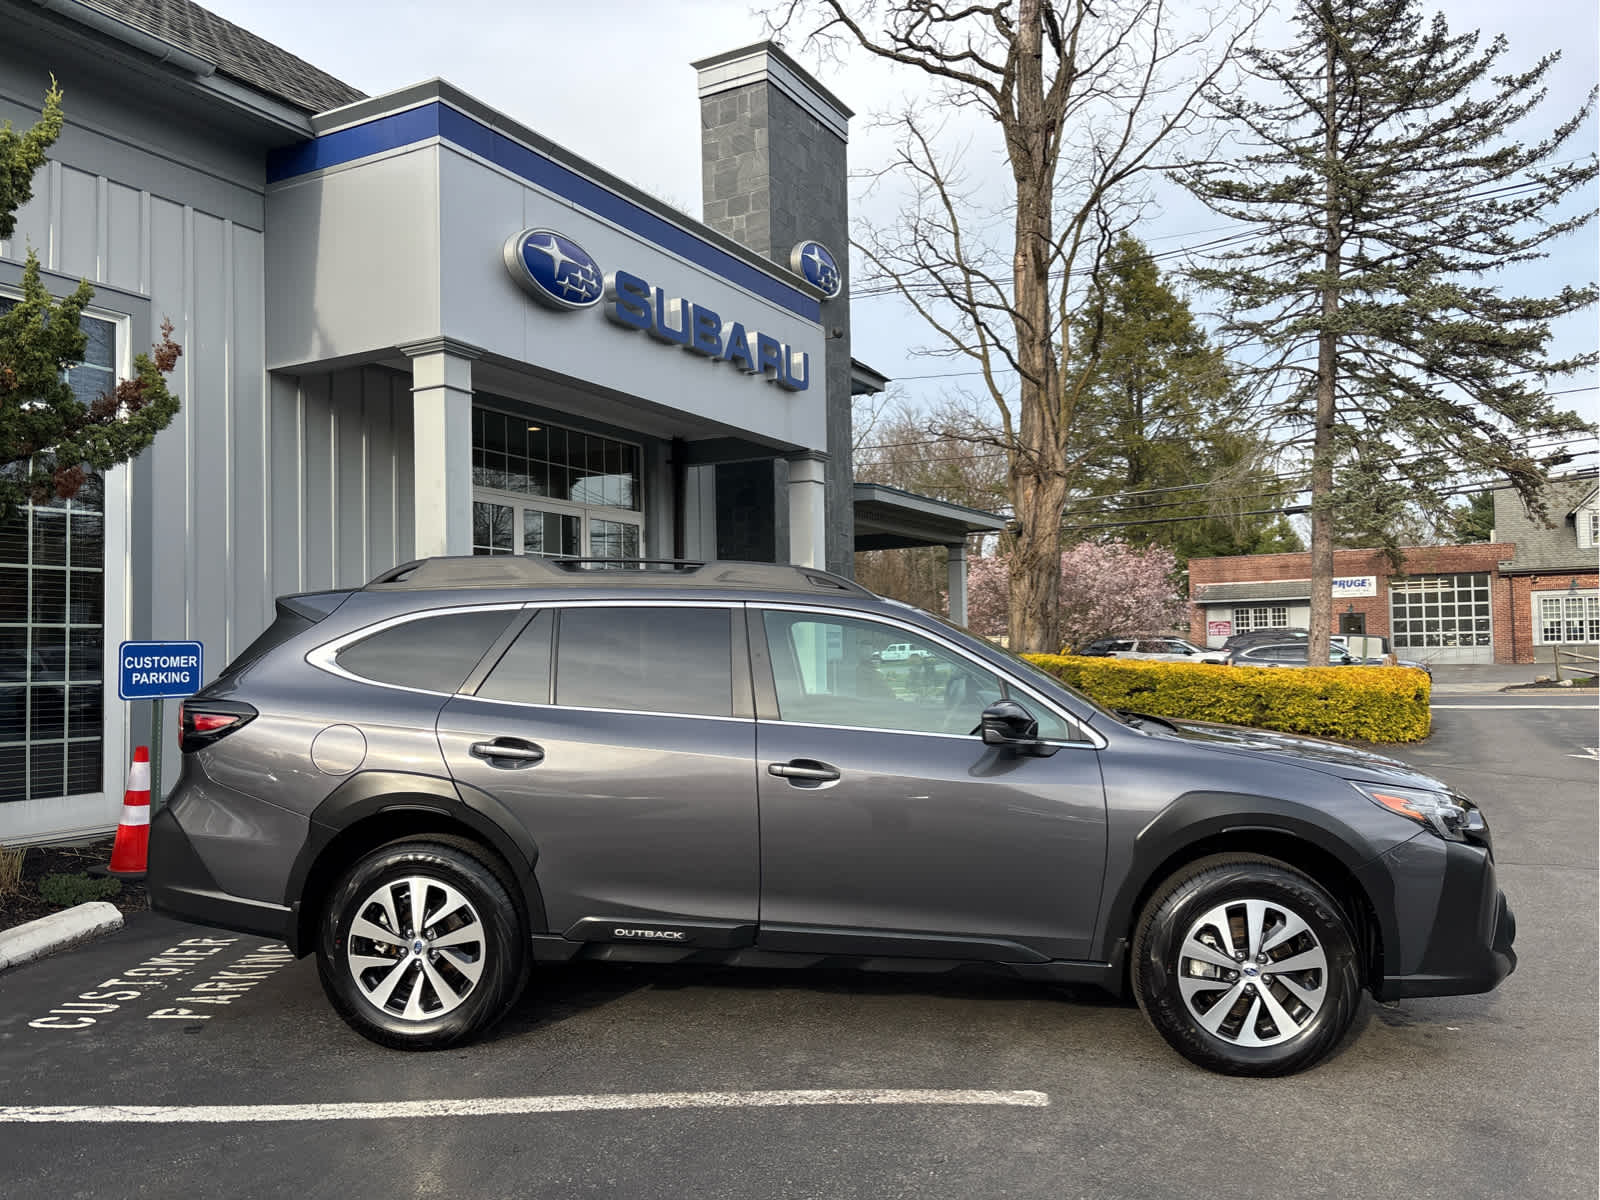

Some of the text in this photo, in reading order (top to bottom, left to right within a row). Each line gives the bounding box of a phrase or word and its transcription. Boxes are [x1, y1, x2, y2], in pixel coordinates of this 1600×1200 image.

[606, 270, 809, 391] SUBARU
[124, 656, 198, 669] CUSTOMER
[131, 671, 190, 685] PARKING
[614, 928, 684, 939] OUTBACK
[28, 938, 240, 1029] CUSTOMER
